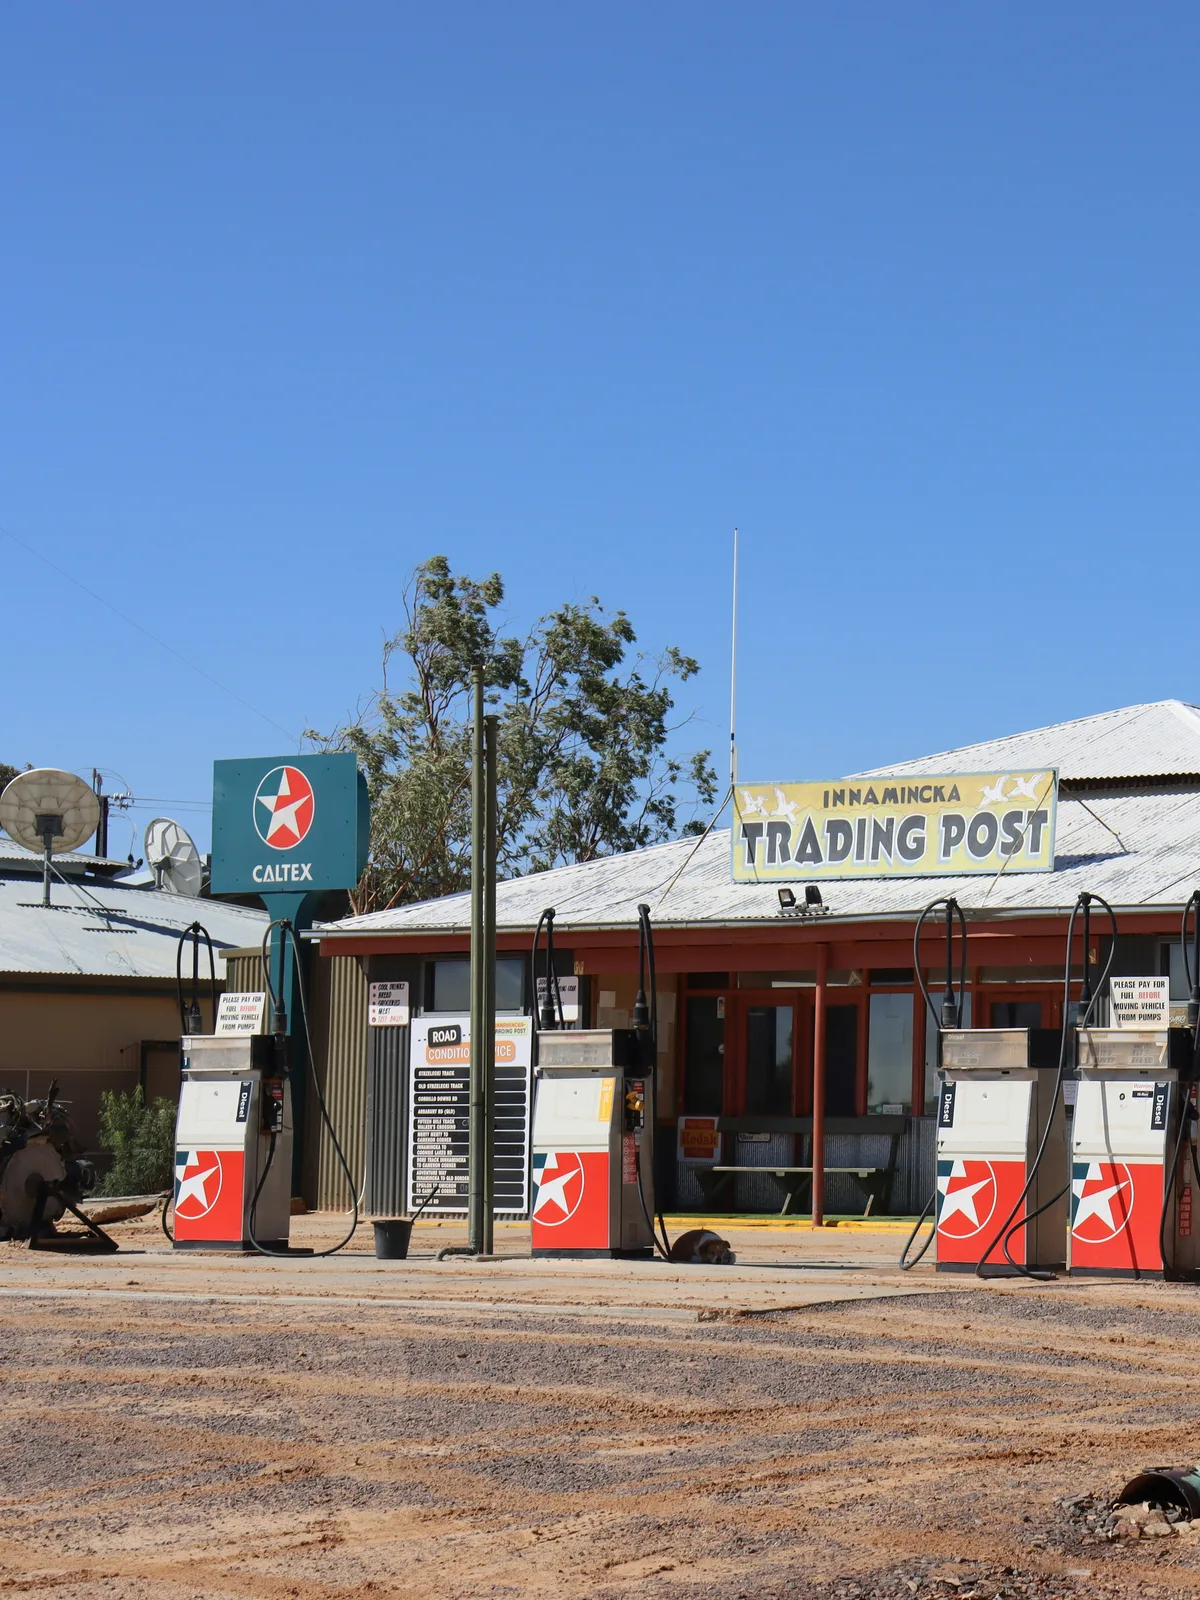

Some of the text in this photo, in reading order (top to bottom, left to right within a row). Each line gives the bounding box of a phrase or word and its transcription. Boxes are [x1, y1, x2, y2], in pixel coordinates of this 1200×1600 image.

[823, 784, 961, 808] INNAMINCKA
[741, 809, 1049, 865] TRADING POST
[252, 863, 313, 883] CALTEX
[1113, 981, 1136, 989] PLEASE
[1153, 980, 1166, 988] FOR
[1138, 991, 1161, 999] BEFORE
[1113, 1002, 1165, 1010] MOVING VEHICLE
[1118, 1013, 1136, 1021] FROM
[1138, 1013, 1161, 1021] PUMPS
[432, 1029, 457, 1043] ROAD
[428, 1046, 470, 1060] CONDITIO
[1155, 1042, 1168, 1063] 7
[239, 1092, 248, 1118] Diesel
[943, 1093, 953, 1122] Diesel
[1154, 1094, 1164, 1125] Diesel
[682, 1131, 717, 1146] Kodak
